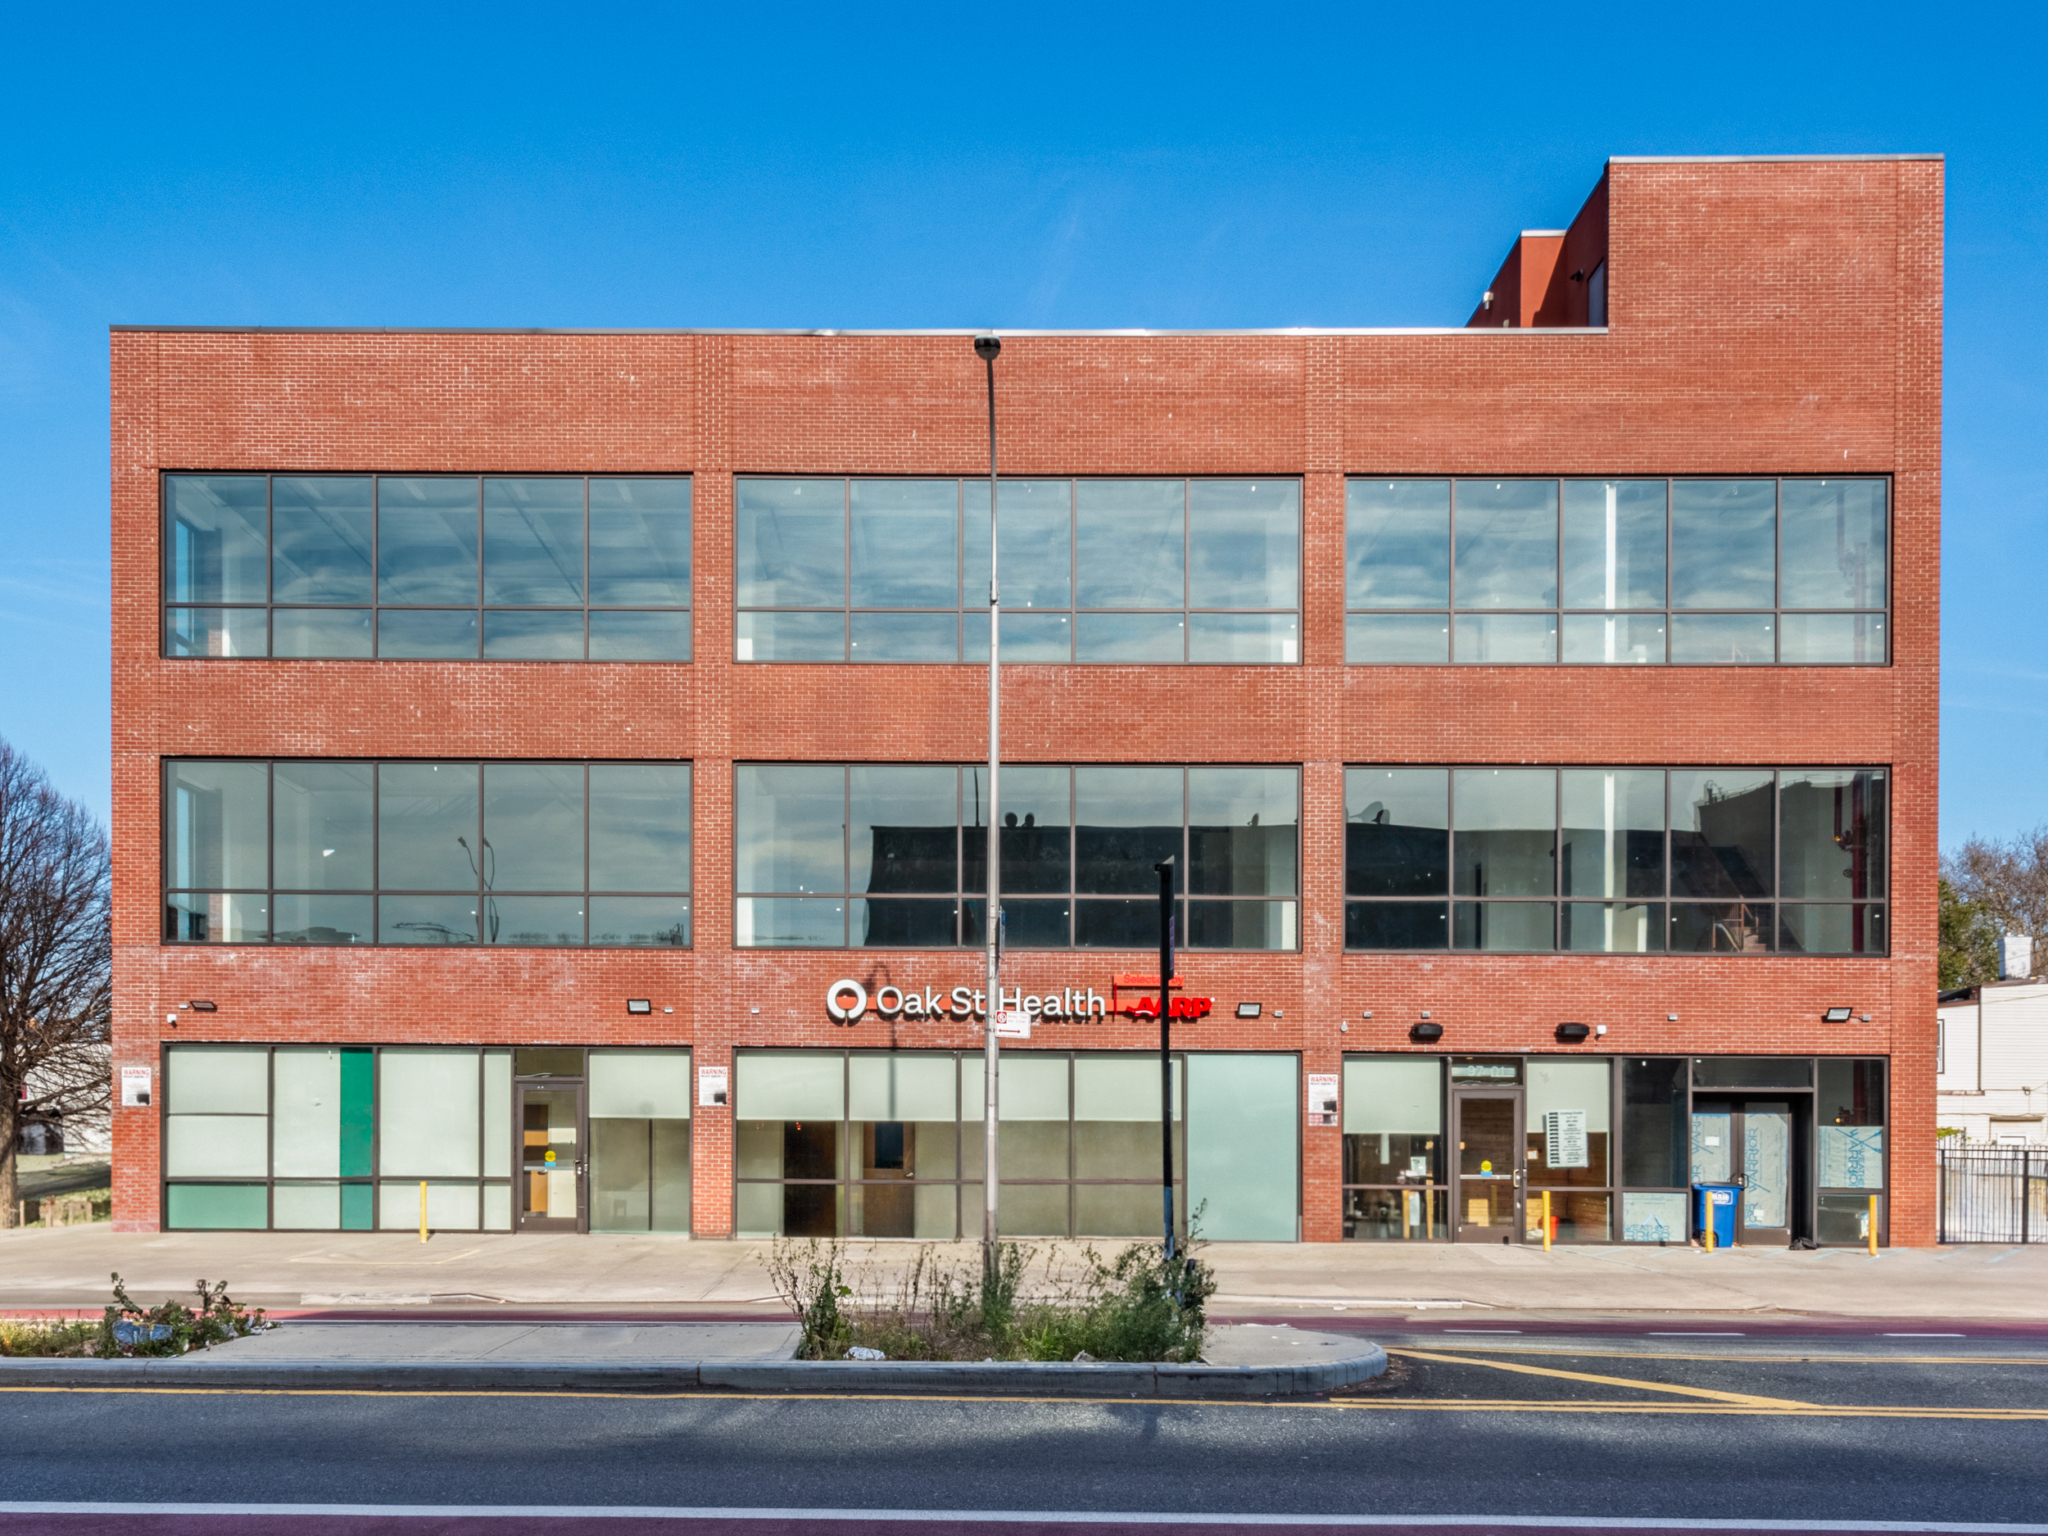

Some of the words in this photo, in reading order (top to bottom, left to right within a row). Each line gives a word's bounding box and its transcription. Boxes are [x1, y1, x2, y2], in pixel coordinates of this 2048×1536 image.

[1123, 974, 1162, 984] Selecte
[877, 985, 945, 1014] Oak
[951, 986, 986, 1015] St
[999, 986, 1106, 1016] Health
[1748, 1127, 1766, 1193] WARRIOR
